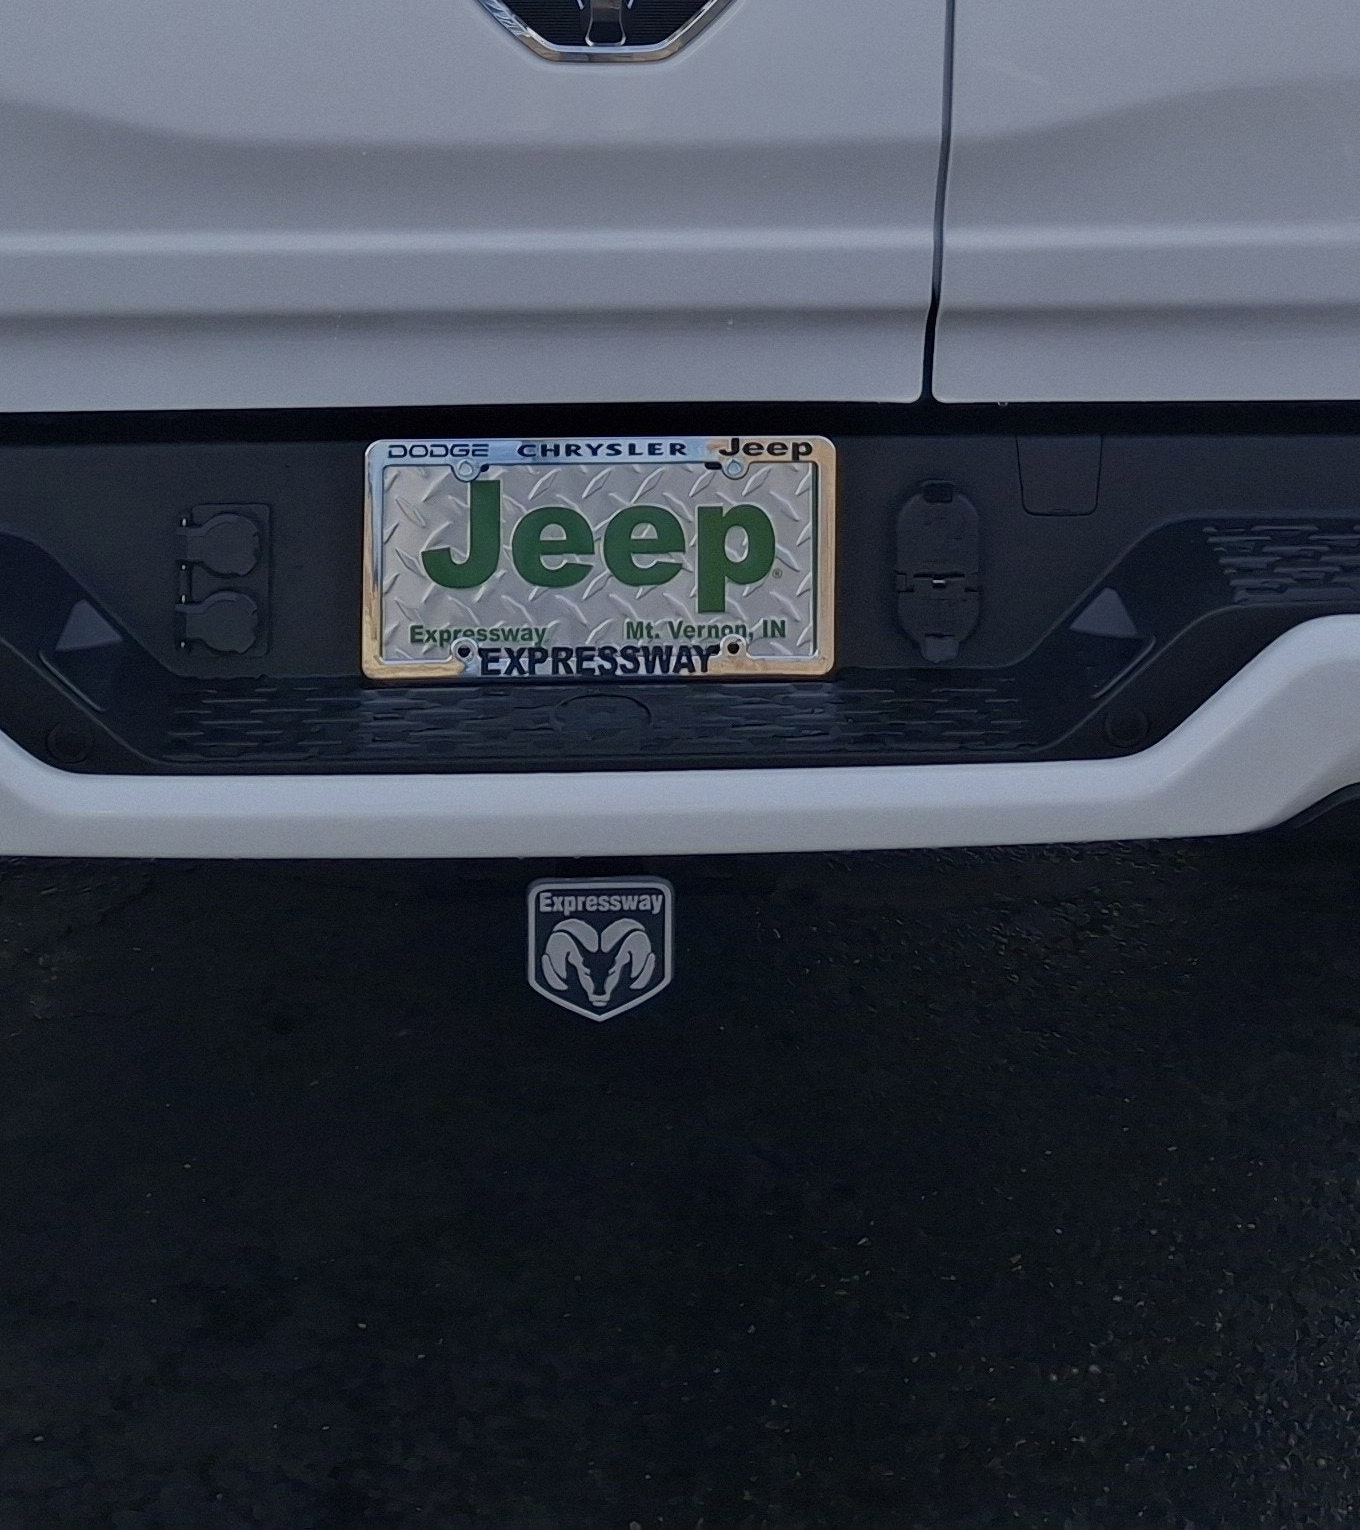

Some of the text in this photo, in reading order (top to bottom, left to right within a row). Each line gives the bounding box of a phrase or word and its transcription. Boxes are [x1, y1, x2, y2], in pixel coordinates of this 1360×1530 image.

[388, 437, 814, 461] DODGE CHRYSLER Jeep
[421, 479, 776, 613] Jeep
[410, 625, 547, 648] Expressway
[626, 621, 659, 639] Mt.
[762, 620, 786, 638] IN
[480, 644, 713, 676] EXPRESSWAY
[539, 892, 663, 916] Expressway
